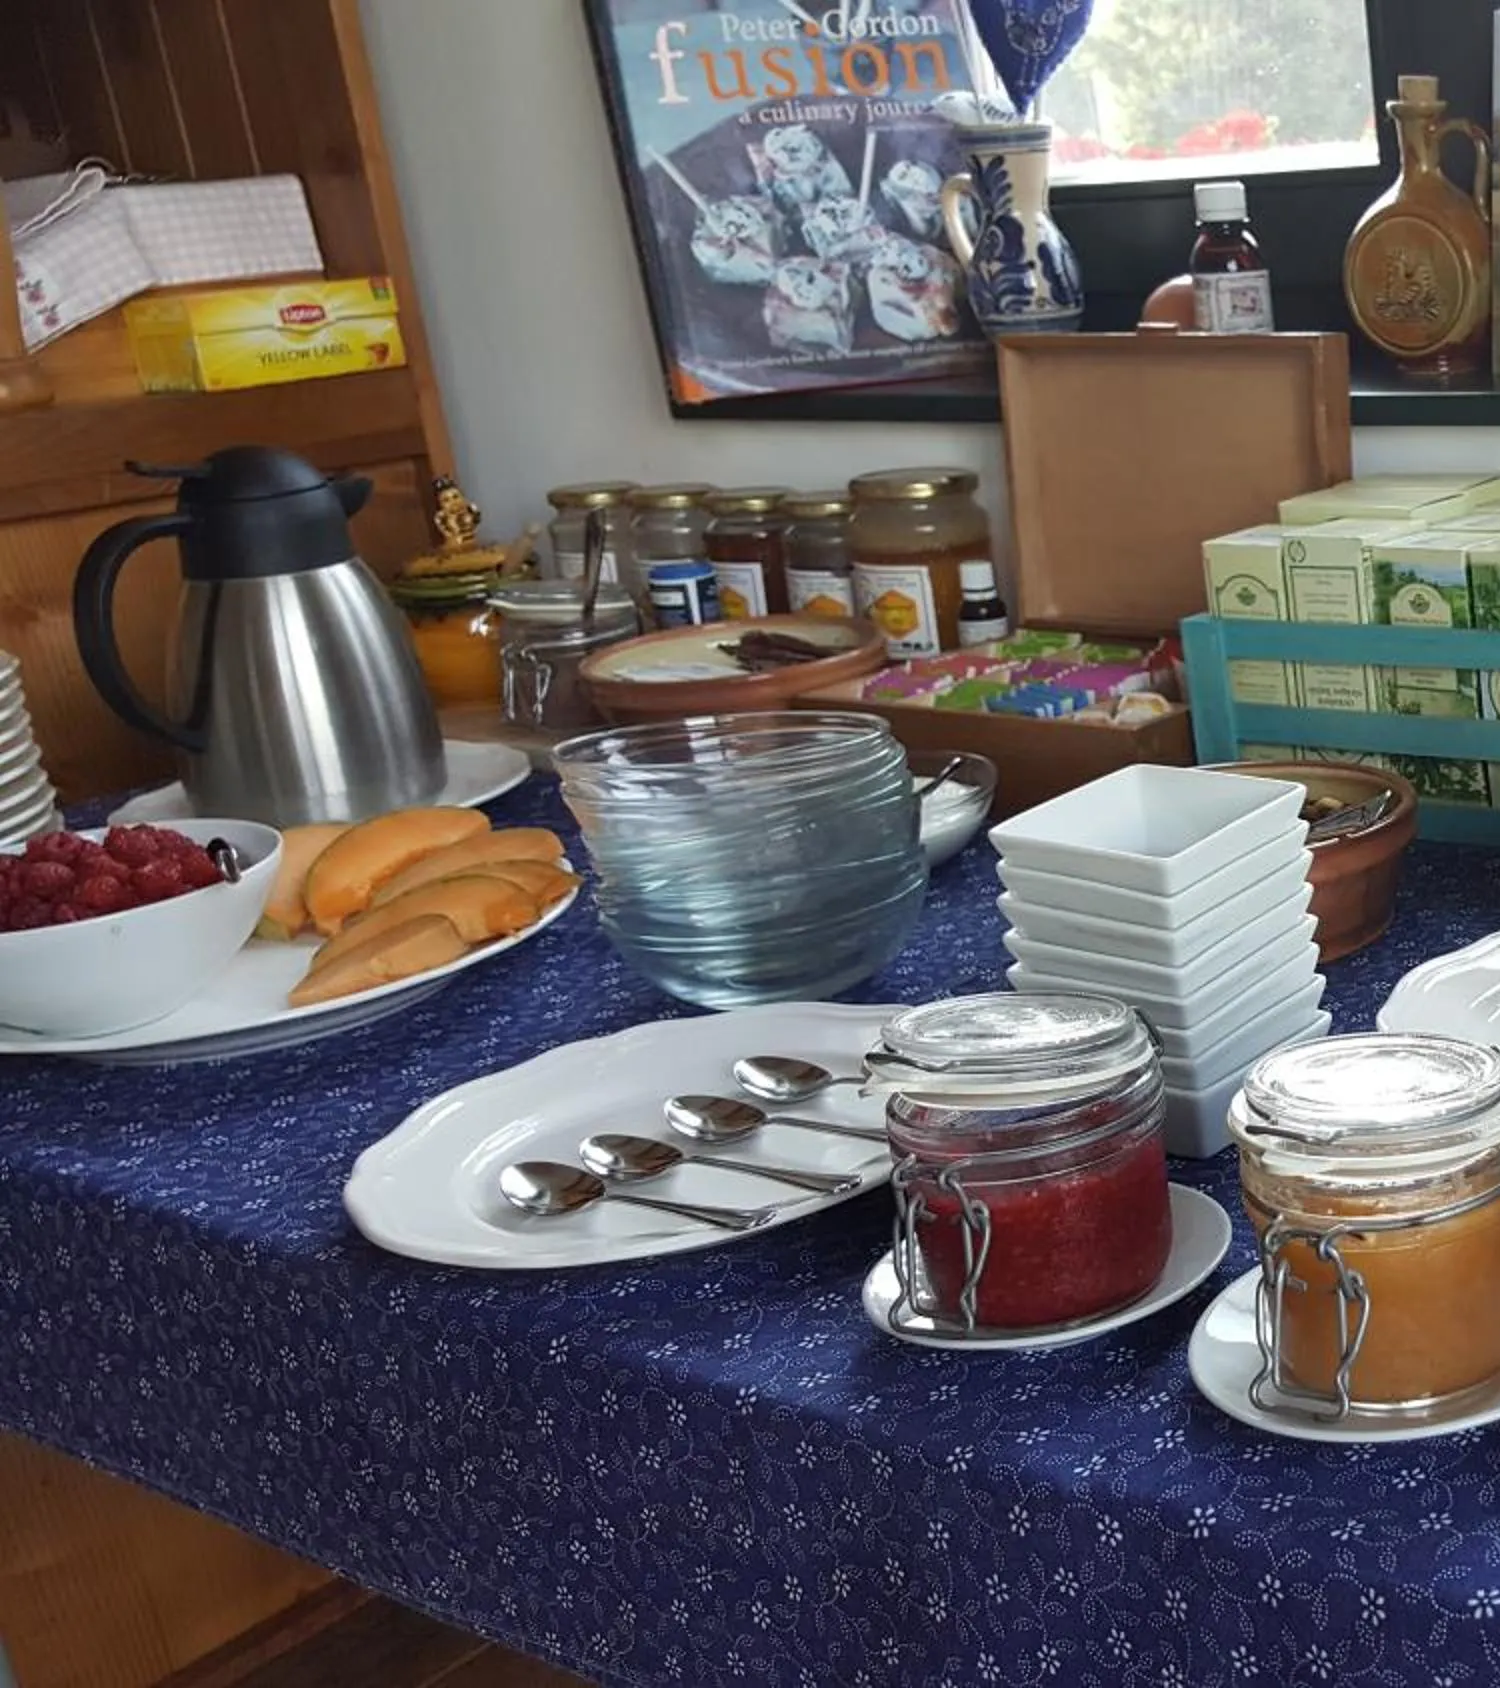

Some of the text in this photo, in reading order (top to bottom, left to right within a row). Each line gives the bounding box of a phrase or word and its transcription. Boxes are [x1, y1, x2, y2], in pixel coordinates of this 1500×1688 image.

[719, 7, 941, 42] Peter Gordon
[648, 20, 951, 105] fusion
[758, 101, 858, 124] culinary
[255, 342, 353, 366] YELLOW LABEL
